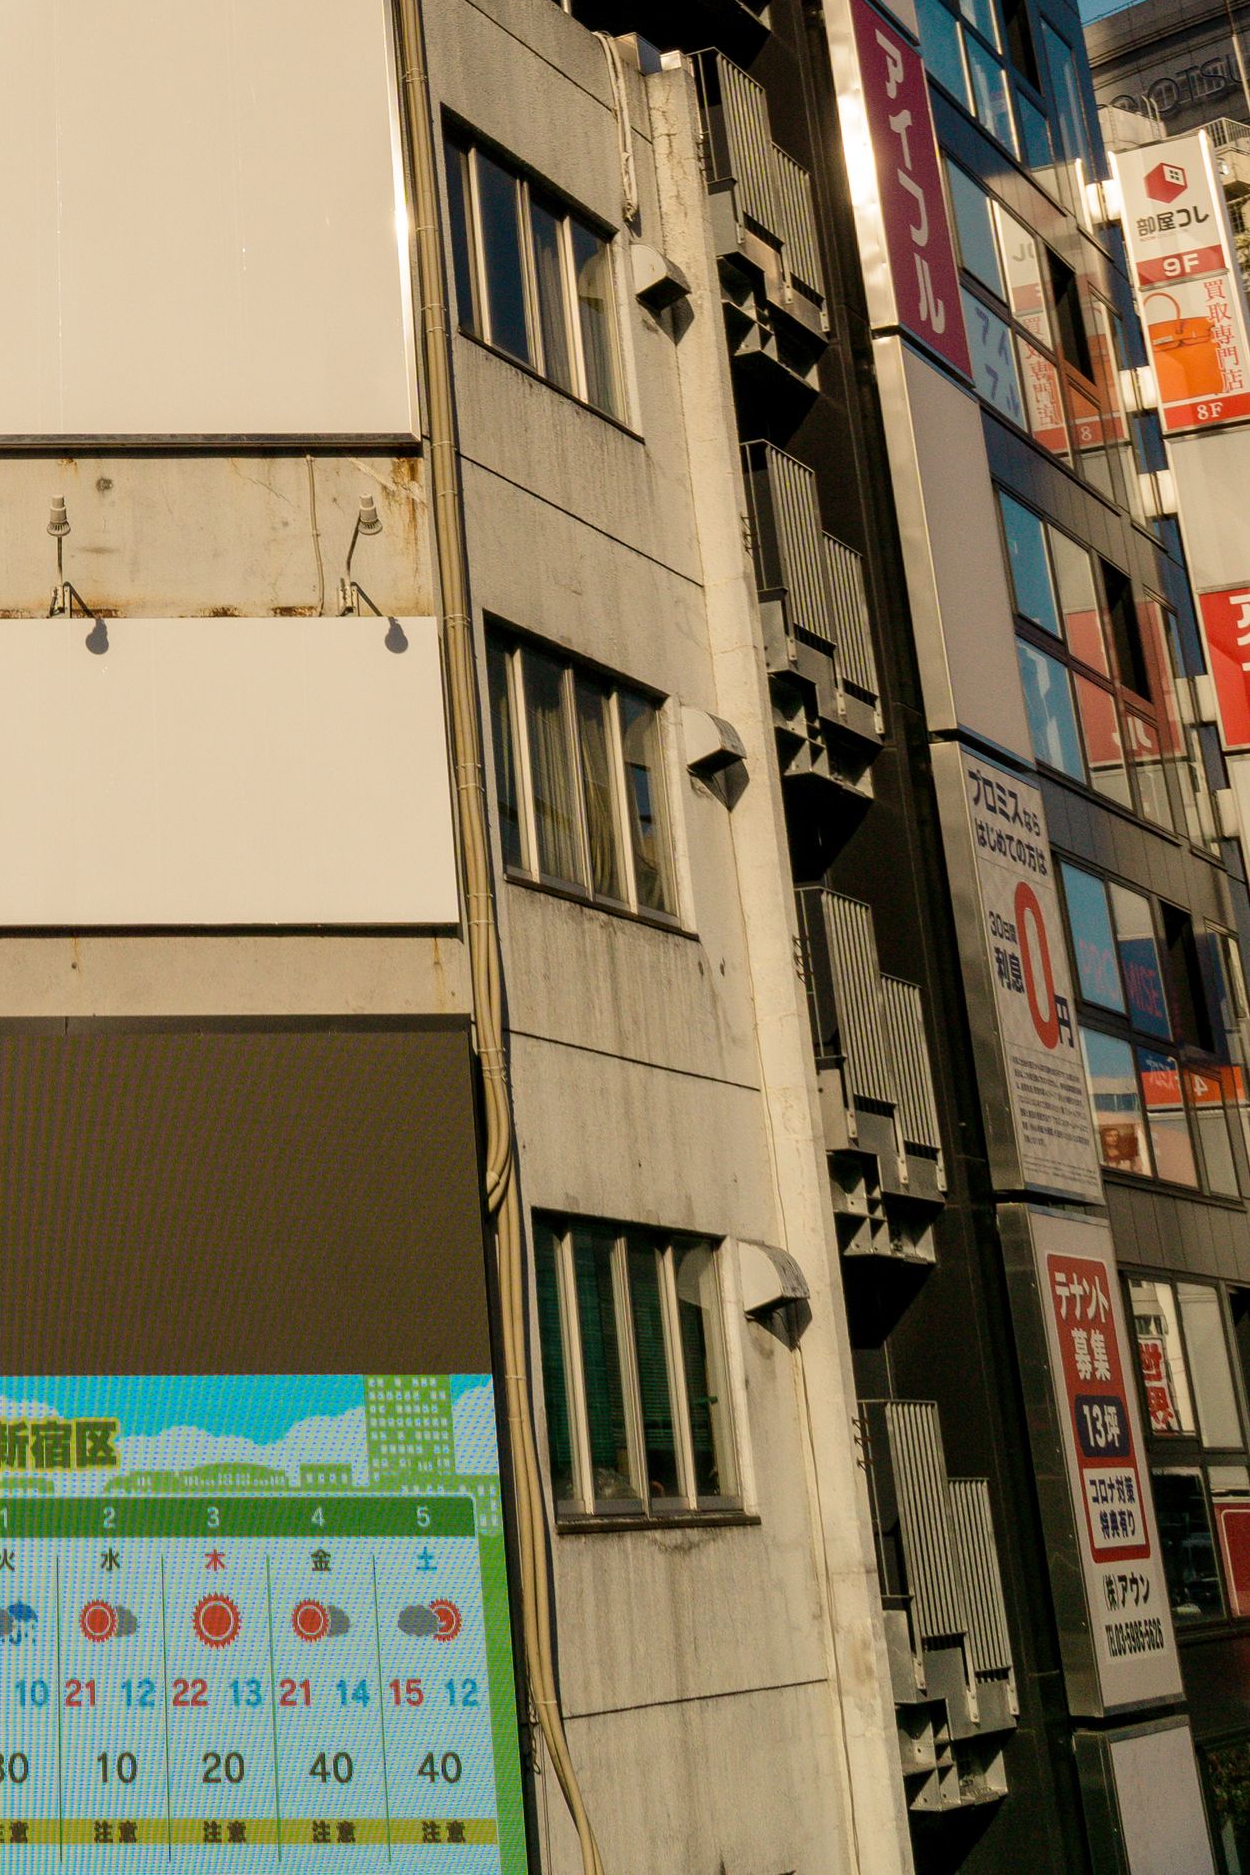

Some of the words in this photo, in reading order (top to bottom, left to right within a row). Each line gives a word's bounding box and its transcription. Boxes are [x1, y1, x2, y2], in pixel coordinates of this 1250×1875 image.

[874, 28, 945, 337] アイフル
[1136, 204, 1210, 237] 部屋コレ
[1163, 253, 1200, 277] 9F
[1203, 279, 1245, 396] 買取専門店
[1196, 401, 1224, 421] 8F
[967, 768, 1041, 837] プロミスなら
[974, 817, 1048, 877] はじめての方は
[993, 945, 1025, 995] 利息
[1054, 1271, 1110, 1324] テナント
[1071, 1327, 1112, 1382] 募集
[1082, 1404, 1121, 1449] 13坪
[1089, 1475, 1136, 1505] コロナ対策
[0, 1506, 8, 1529] 1
[103, 1506, 116, 1528] 2
[206, 1506, 220, 1528] 3
[310, 1506, 326, 1527] 4
[416, 1505, 431, 1527] 5
[1099, 1508, 1136, 1540] 特典有り
[100, 1547, 120, 1572] 水
[205, 1548, 226, 1572] 木
[310, 1548, 332, 1572] 金
[415, 1546, 438, 1571] 土
[15, 1678, 49, 1708] 10
[64, 1678, 96, 1708] 21
[121, 1678, 155, 1708] 12
[172, 1678, 209, 1708] 22
[229, 1678, 263, 1708] 13
[279, 1678, 312, 1708] 21
[335, 1678, 371, 1708] 14
[389, 1678, 425, 1708] 15
[445, 1678, 479, 1708] 12
[97, 1751, 138, 1785] 10
[202, 1751, 245, 1785] 20
[309, 1751, 354, 1785] 40
[417, 1751, 463, 1785] 40
[93, 1819, 139, 1844] 注意
[203, 1819, 248, 1844] 注意
[311, 1819, 357, 1844] 注意
[421, 1819, 467, 1844] 注意
